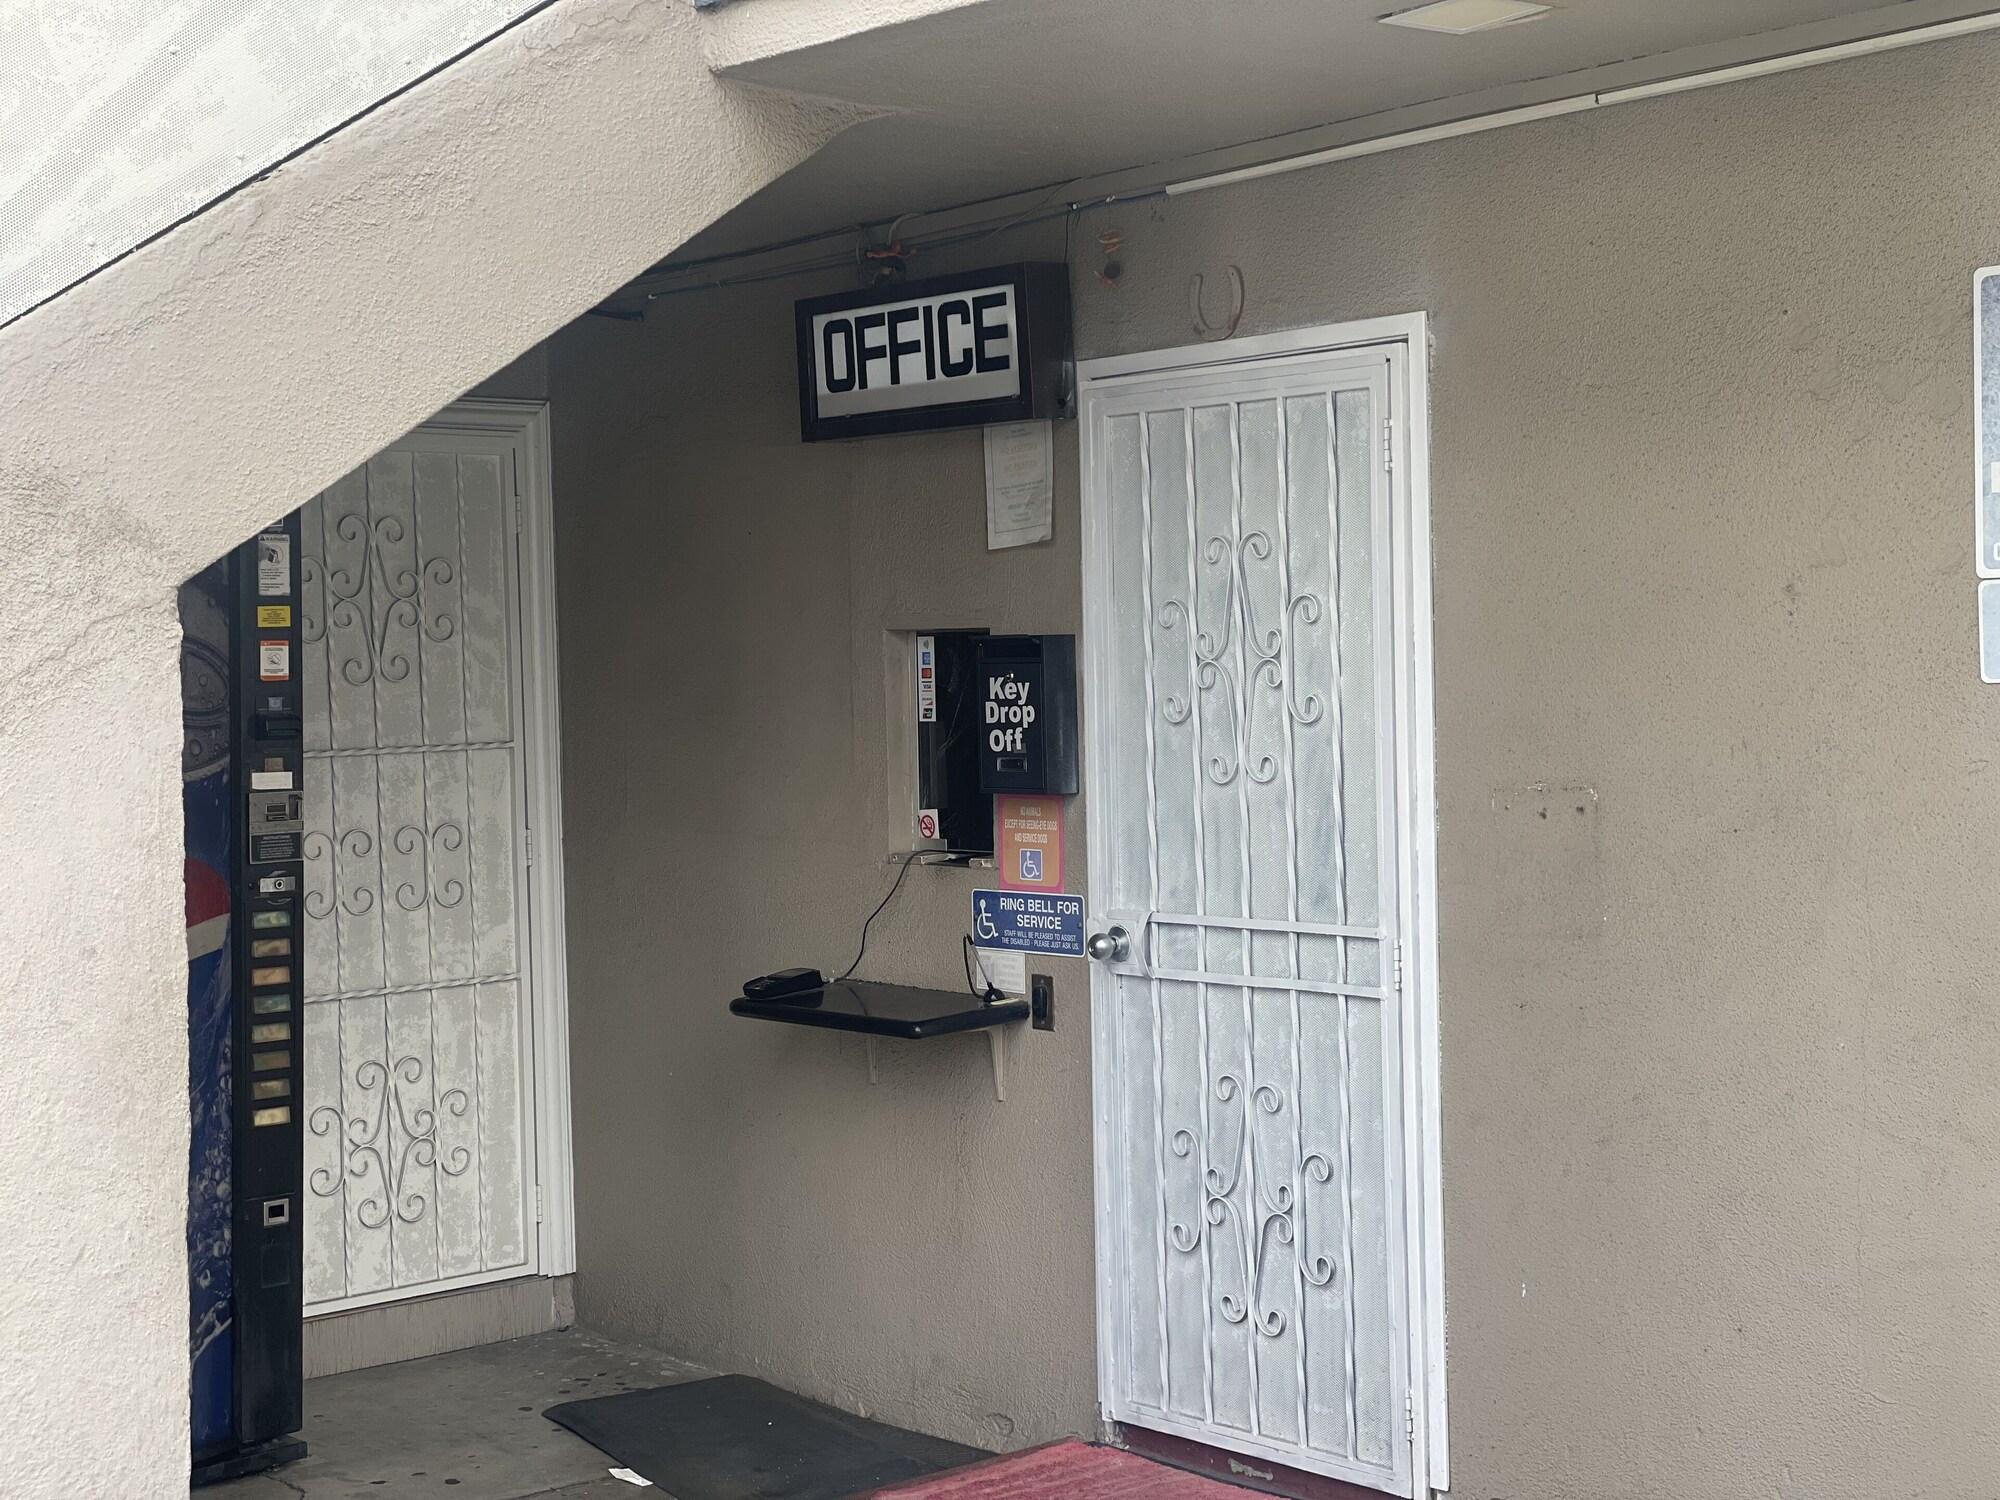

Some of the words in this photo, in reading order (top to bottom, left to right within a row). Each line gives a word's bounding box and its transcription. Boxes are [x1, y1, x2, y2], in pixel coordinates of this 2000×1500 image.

[823, 292, 1010, 393] OFFICE
[989, 677, 1030, 705] Key
[985, 701, 1035, 728] Drop
[989, 728, 1023, 752] Off
[1000, 898, 1025, 911] RING
[1028, 900, 1054, 913] BELL
[1057, 901, 1079, 915] FOR
[1017, 914, 1062, 929] SERVICE
[1004, 929, 1016, 937] STAFF
[1017, 930, 1027, 938] WILL
[1028, 931, 1034, 939] BE
[1034, 932, 1053, 940] PLEASED
[1061, 934, 1076, 942] ASSIST
[1010, 938, 1030, 946] DISABLED
[1034, 939, 1050, 947] PLEASE
[1050, 940, 1061, 948] JUST
[1062, 941, 1071, 949] ASK
